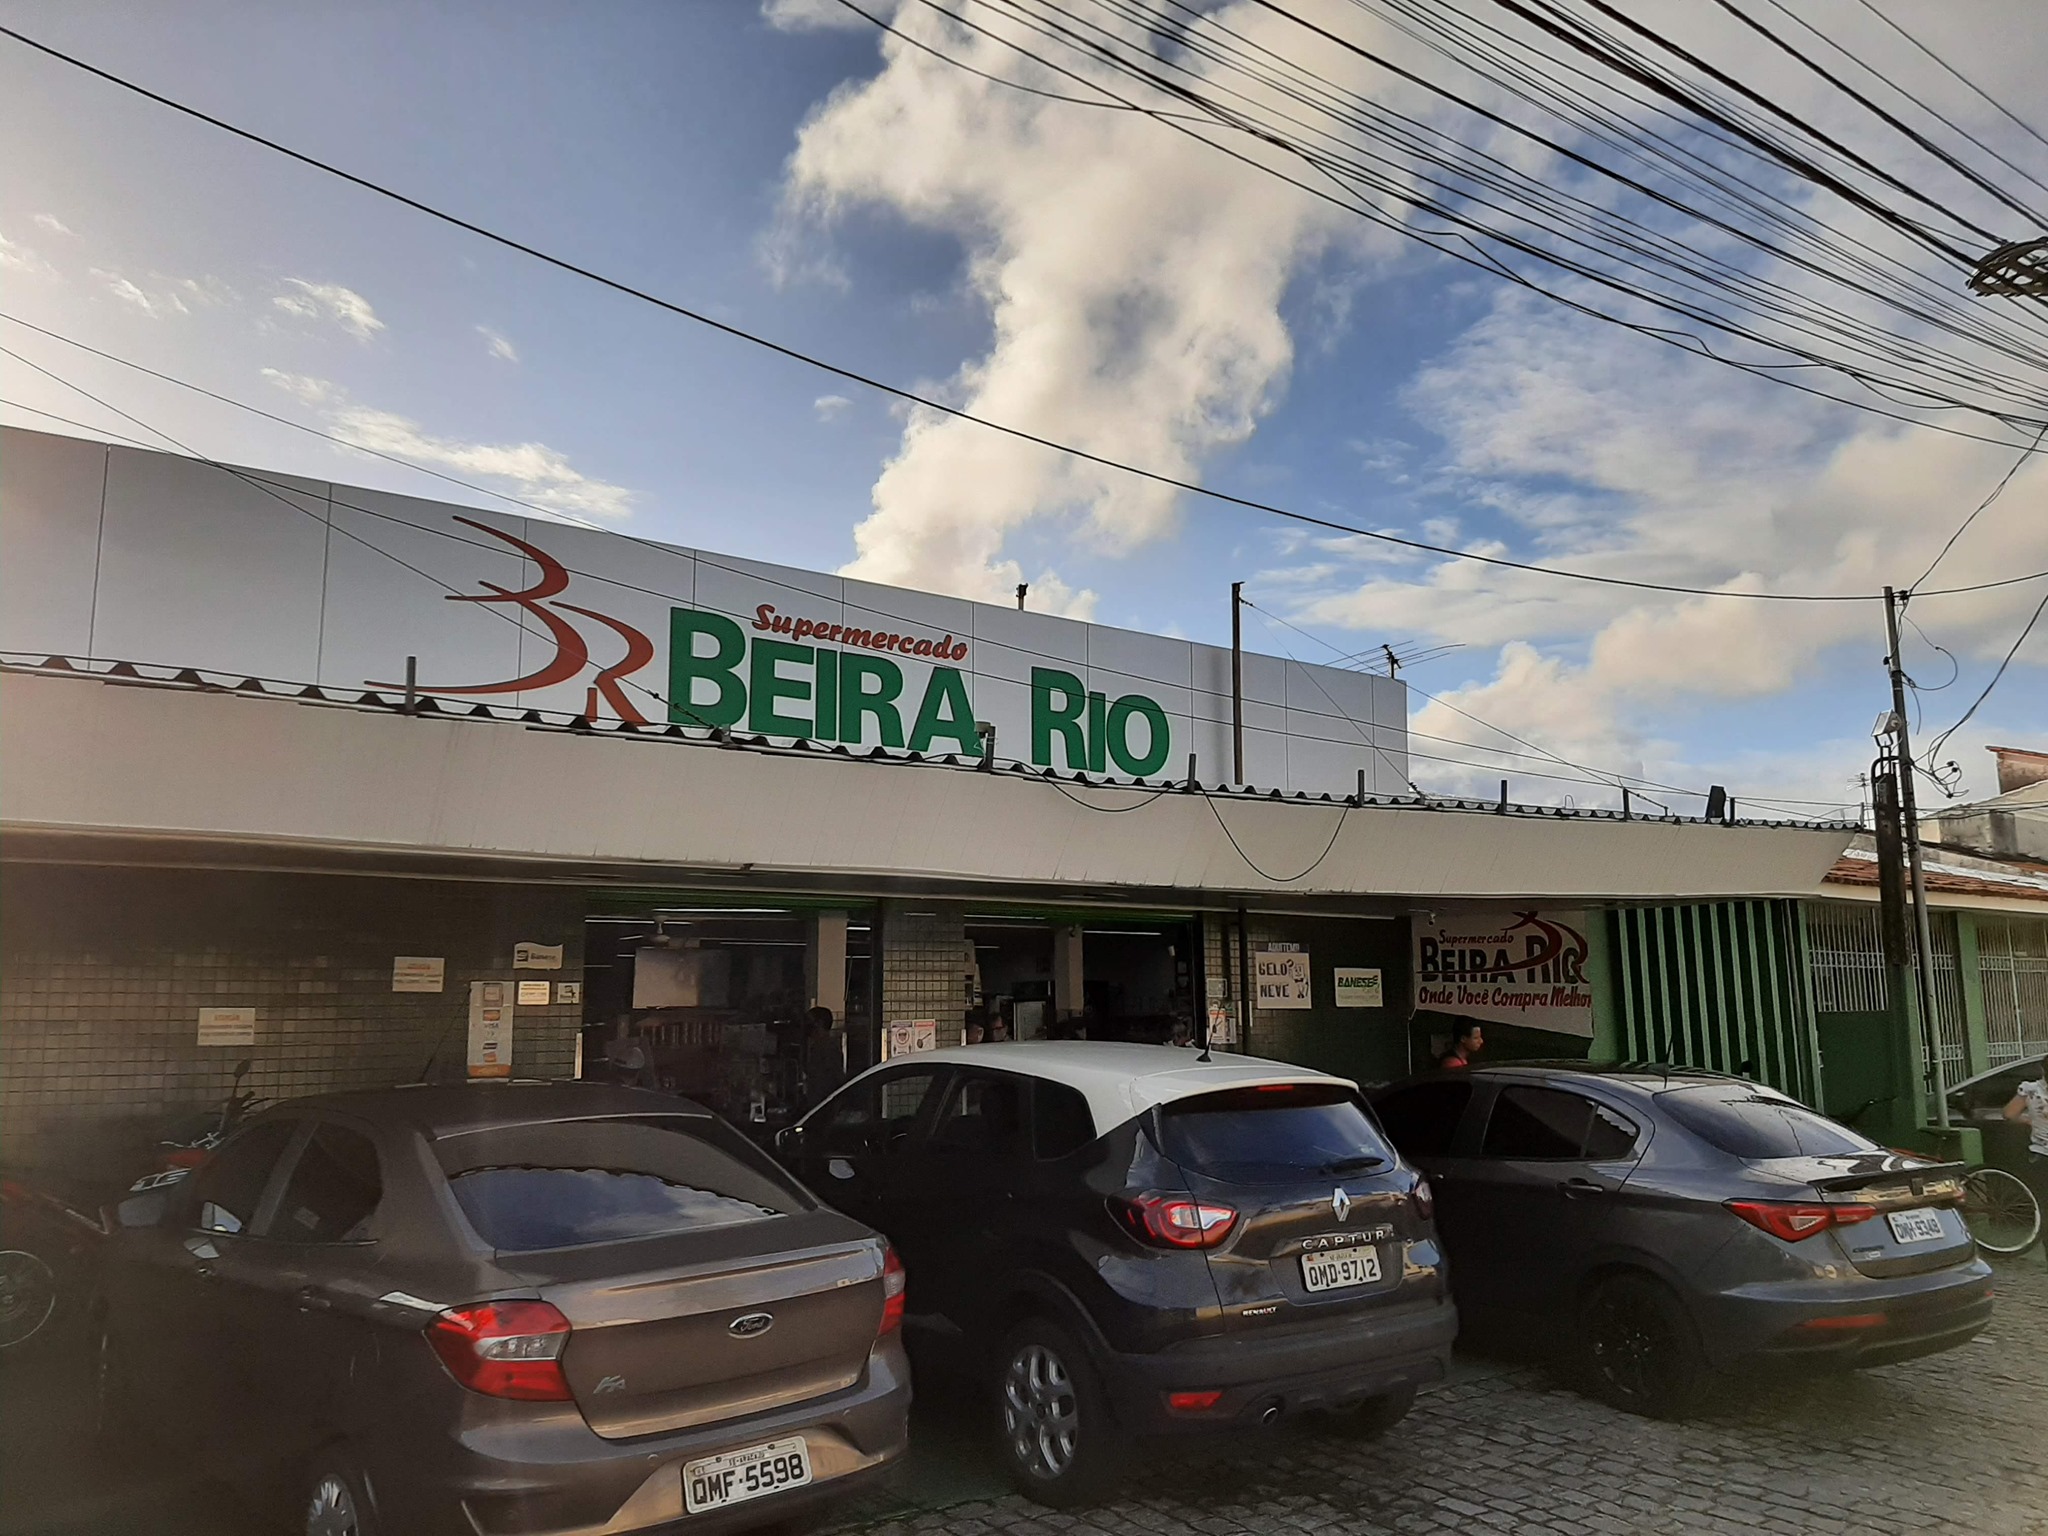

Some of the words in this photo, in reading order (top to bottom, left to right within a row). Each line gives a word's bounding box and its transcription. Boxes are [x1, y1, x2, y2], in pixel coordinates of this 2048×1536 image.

[751, 603, 969, 661] Supermercado
[669, 606, 984, 758] BEIRA
[1030, 666, 1171, 776] RIO
[1438, 929, 1514, 948] Supermercado
[1258, 962, 1288, 976] GELO
[1419, 936, 1516, 984] BEIRA
[1260, 984, 1290, 998] NEVE
[1418, 985, 1453, 1005] Onde
[1457, 985, 1489, 1006] Você
[1491, 988, 1549, 1012] Compra
[1302, 1230, 1385, 1250] CAPTUR
